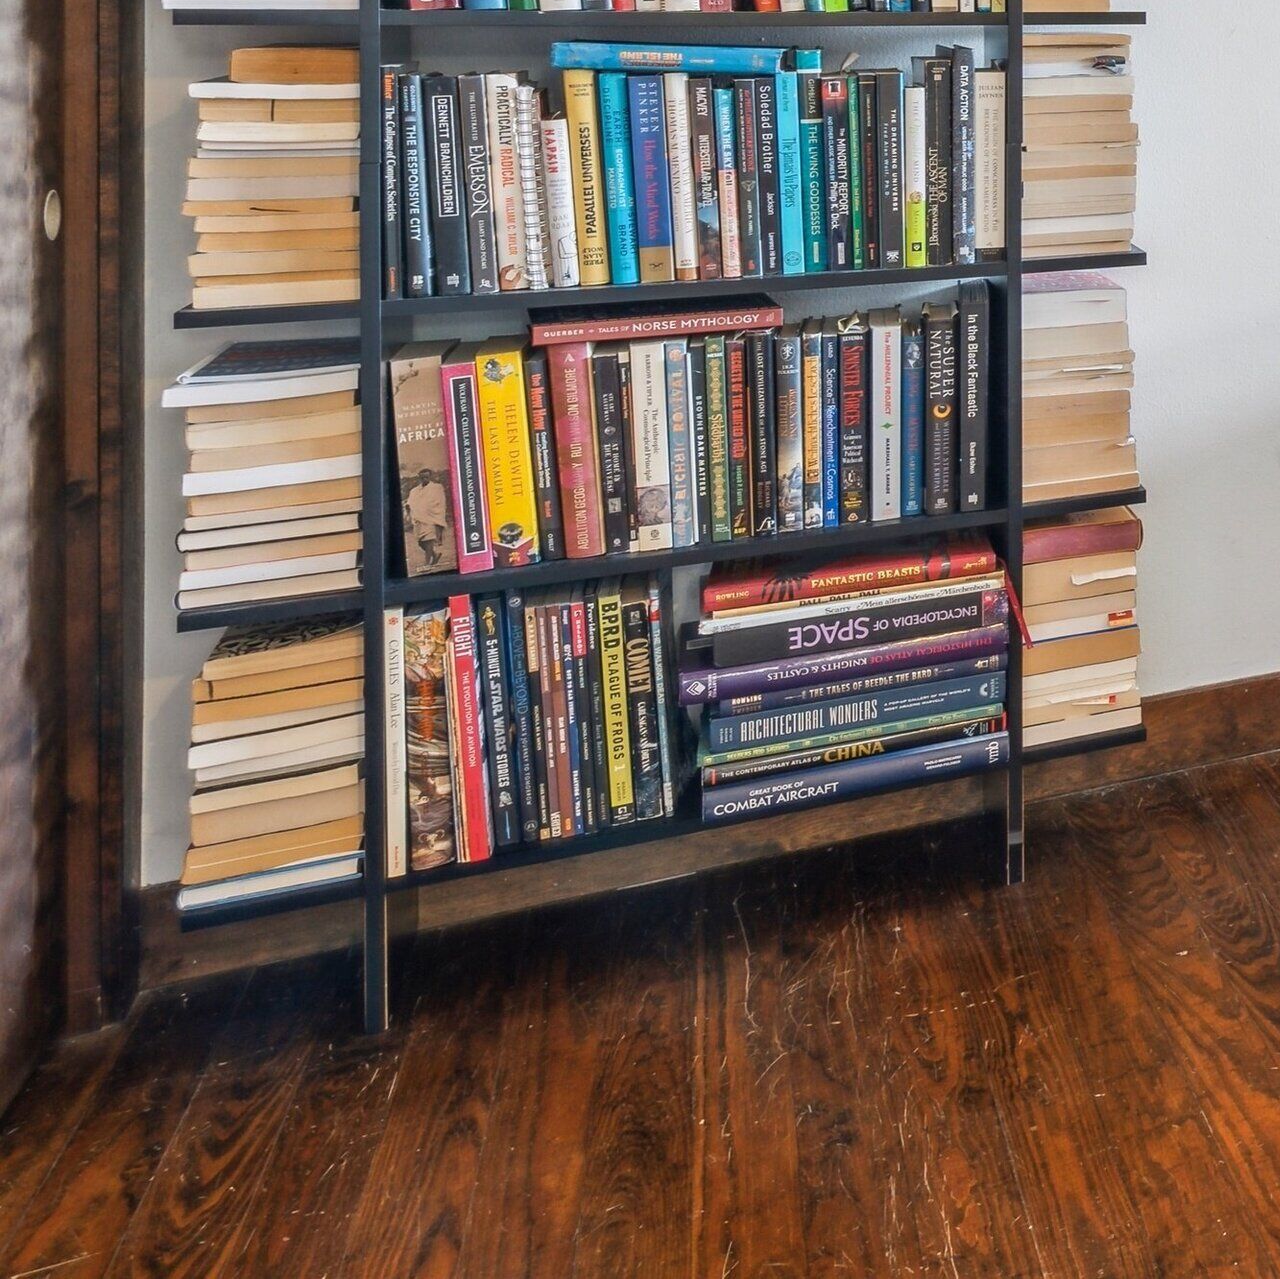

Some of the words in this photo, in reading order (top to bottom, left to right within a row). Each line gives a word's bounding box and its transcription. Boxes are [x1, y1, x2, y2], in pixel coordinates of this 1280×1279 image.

[384, 73, 394, 99] Tainter
[960, 65, 969, 88] DATA
[638, 82, 649, 134] PINKER
[648, 82, 660, 132] STEVEN
[696, 87, 708, 116] MACVEY
[759, 86, 772, 128] Soledad
[808, 79, 817, 114] GIMBUTAS
[960, 89, 969, 120] ACTION
[386, 106, 395, 121] The
[437, 98, 451, 138] DENNETT
[496, 85, 513, 146] PRACTICALLY
[385, 122, 395, 151] Collapse
[407, 125, 416, 146] THE
[808, 125, 818, 144] THE
[386, 151, 395, 159] of
[501, 148, 515, 187] RADICAL
[579, 127, 592, 182] UNIVERSES
[699, 135, 711, 183] INTERSTELLAR
[761, 133, 773, 174] Brother
[809, 146, 819, 178] LIVING
[837, 138, 847, 179] MINORITY
[385, 160, 396, 190] Complex
[407, 149, 419, 215] RESPONSIVE
[441, 143, 455, 214] BRAINCHILDREN
[468, 145, 489, 217] EMERSON
[386, 192, 396, 221] Societies
[584, 184, 595, 234] PARALLEL
[701, 184, 712, 208] TRAVEL
[810, 181, 821, 235] GODDESSES
[839, 182, 848, 215] REPORT
[410, 218, 421, 241] CITY
[544, 329, 584, 337] GUERBER
[632, 320, 676, 333] NORSE
[681, 313, 760, 328] MYTHOLOGY
[968, 314, 978, 323] In
[968, 324, 978, 340] the
[845, 346, 861, 387] SINISTER
[929, 330, 941, 399] NATURAL
[942, 346, 954, 398] SUPER
[968, 342, 978, 370] Black
[459, 383, 469, 412] WOLFRAM
[827, 369, 835, 398] Science
[968, 372, 978, 417] Fantastic
[488, 401, 498, 421] THE
[504, 404, 519, 444] HELEN
[847, 390, 863, 425] FORCES
[462, 417, 473, 446] CELLULAR
[490, 427, 501, 452] LAST
[711, 414, 722, 463] Siddhartha
[463, 447, 474, 478] AUTOMATA
[466, 479, 475, 490] AND
[492, 457, 505, 506] SAMURAI
[827, 469, 836, 499] Cosmos
[466, 492, 477, 526] COMPLEXITY
[811, 572, 874, 589] FANTASTIC
[878, 565, 920, 579] BEASTS
[716, 591, 749, 601] ROWLING
[872, 620, 890, 631] OF
[893, 605, 978, 625] ENCYCLOPEDIA
[453, 616, 472, 658] FLIGHT
[789, 617, 869, 649] SPACE
[388, 640, 400, 685] CASTLES
[486, 640, 502, 679] 5-MINUTE
[626, 638, 651, 693] COMET
[608, 655, 621, 700] PLAGUE
[809, 688, 823, 697] THE
[825, 684, 850, 695] TALES
[853, 681, 862, 690] OF
[864, 676, 892, 689] BEEDLE
[894, 673, 908, 684] THE
[910, 669, 932, 682] BARD
[489, 680, 504, 715] STAR
[610, 703, 622, 717] OF
[493, 717, 505, 752] WARS
[741, 715, 824, 742] ARCHITECTURAL
[829, 700, 878, 727] WONDERS
[612, 722, 624, 760] FROGS
[824, 741, 885, 763] CHINA
[497, 754, 509, 787] STORIES
[714, 796, 775, 816] COMBAT
[778, 781, 839, 804] AIRCRAFT
